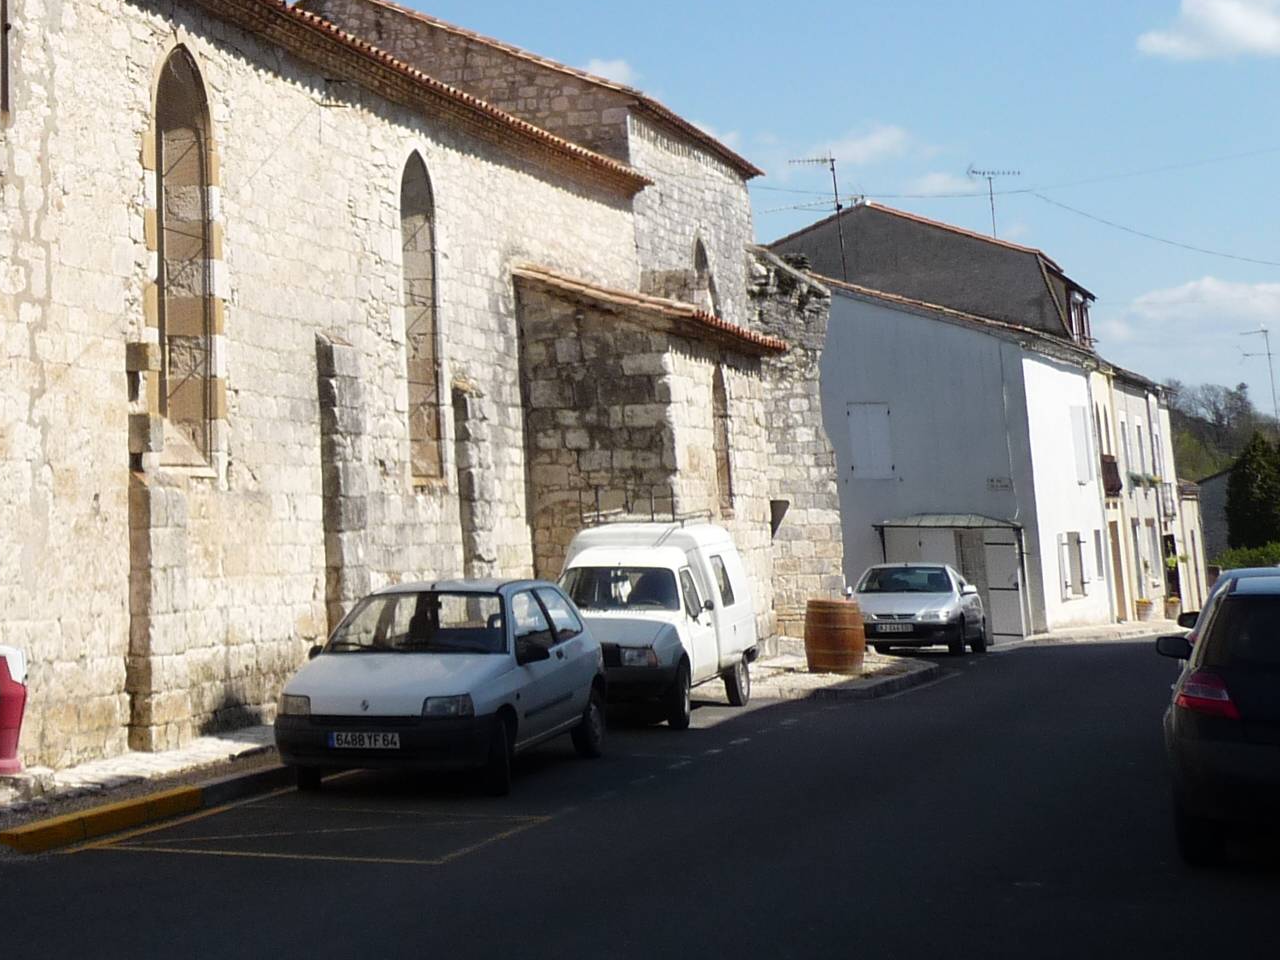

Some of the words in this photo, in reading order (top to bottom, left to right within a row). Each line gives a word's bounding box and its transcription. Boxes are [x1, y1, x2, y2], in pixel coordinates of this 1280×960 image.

[336, 733, 365, 746] 6488
[367, 734, 381, 746] YF
[382, 734, 397, 747] 64
